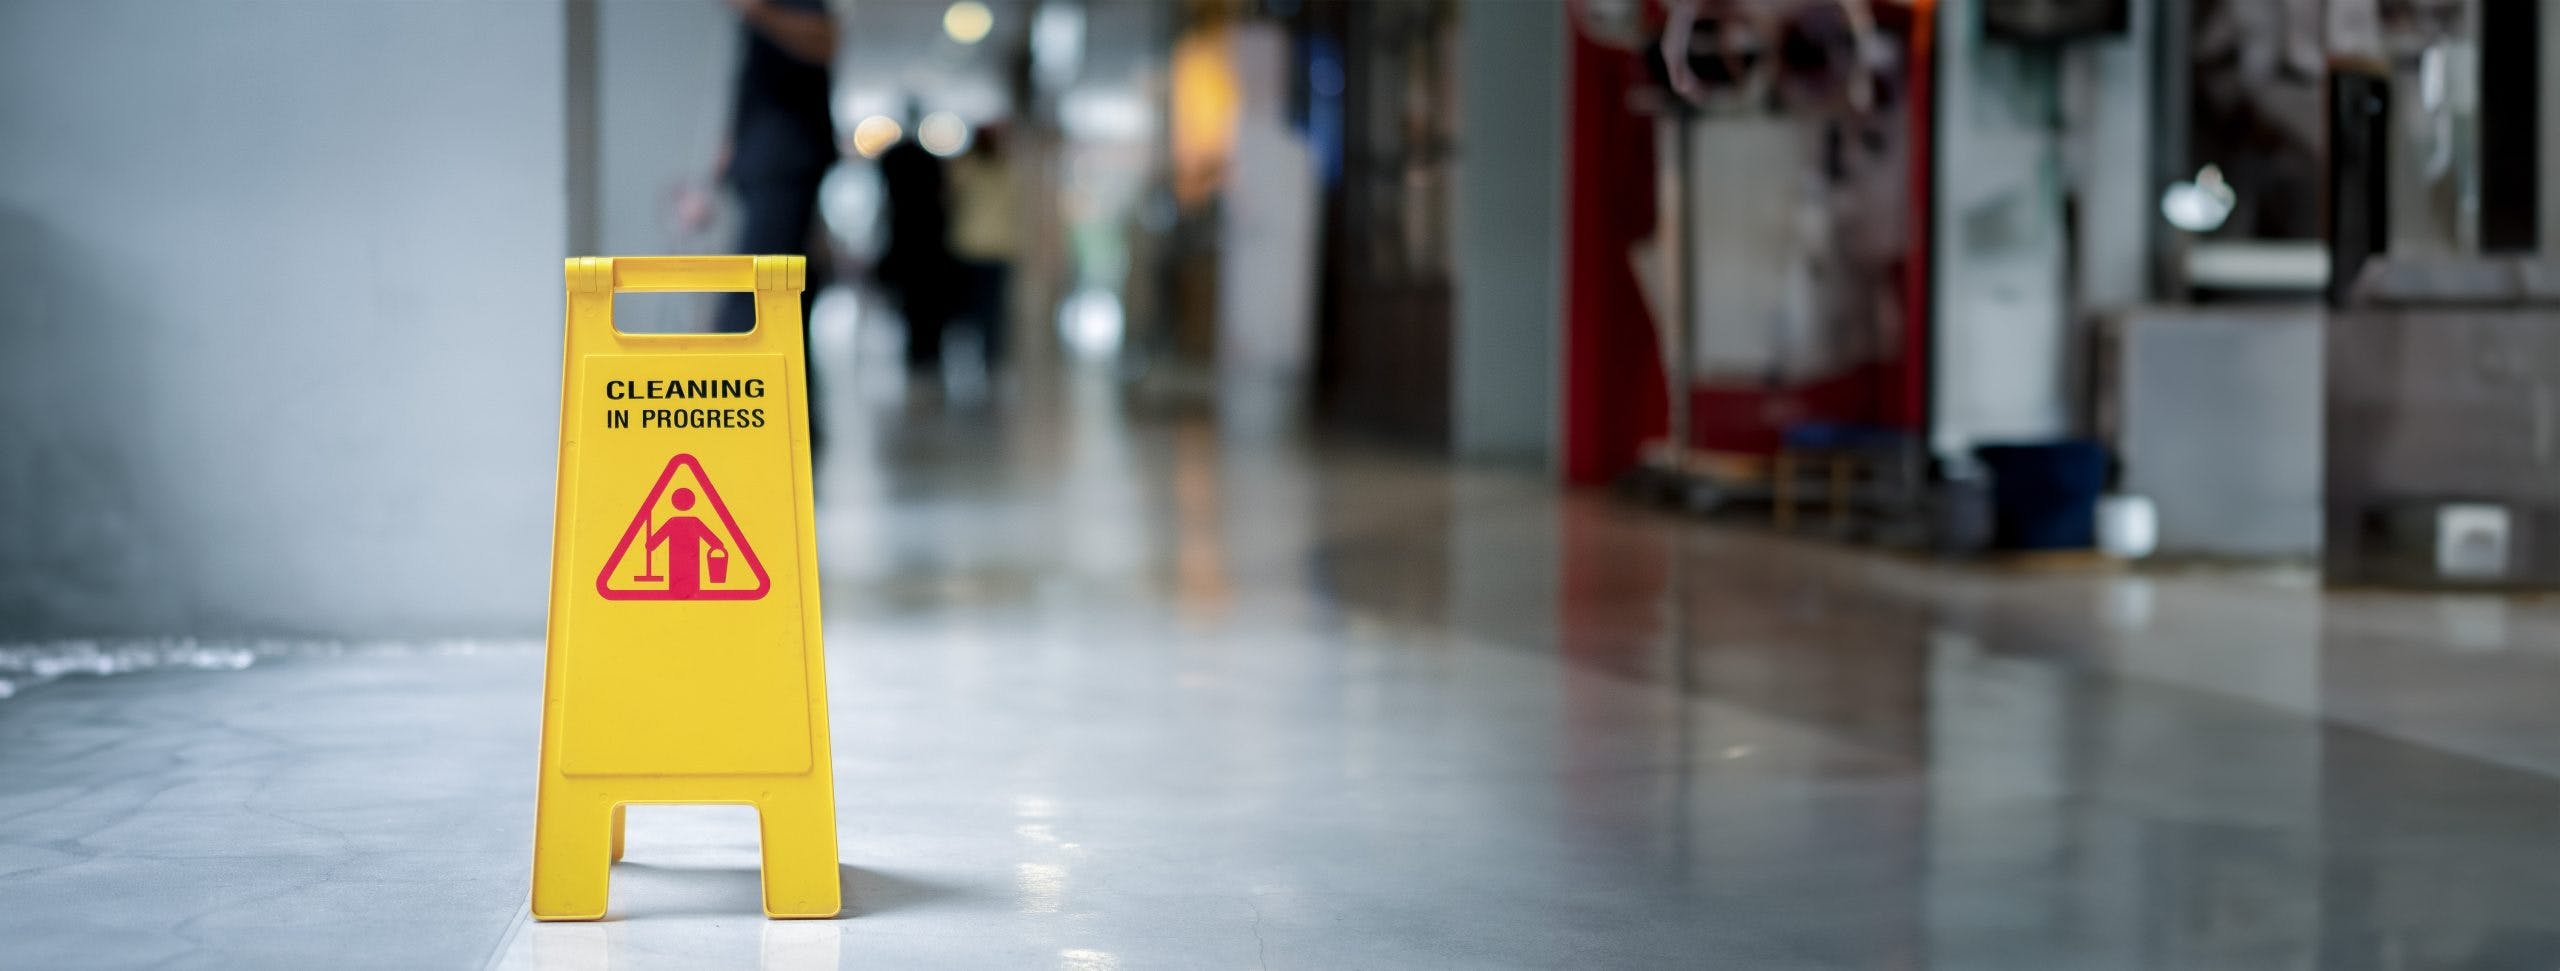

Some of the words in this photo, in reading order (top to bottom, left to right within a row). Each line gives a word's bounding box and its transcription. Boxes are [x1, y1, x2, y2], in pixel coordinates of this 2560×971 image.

[606, 379, 765, 399] CLEANING
[607, 409, 629, 428] IN
[642, 408, 765, 428] PROGRESS
